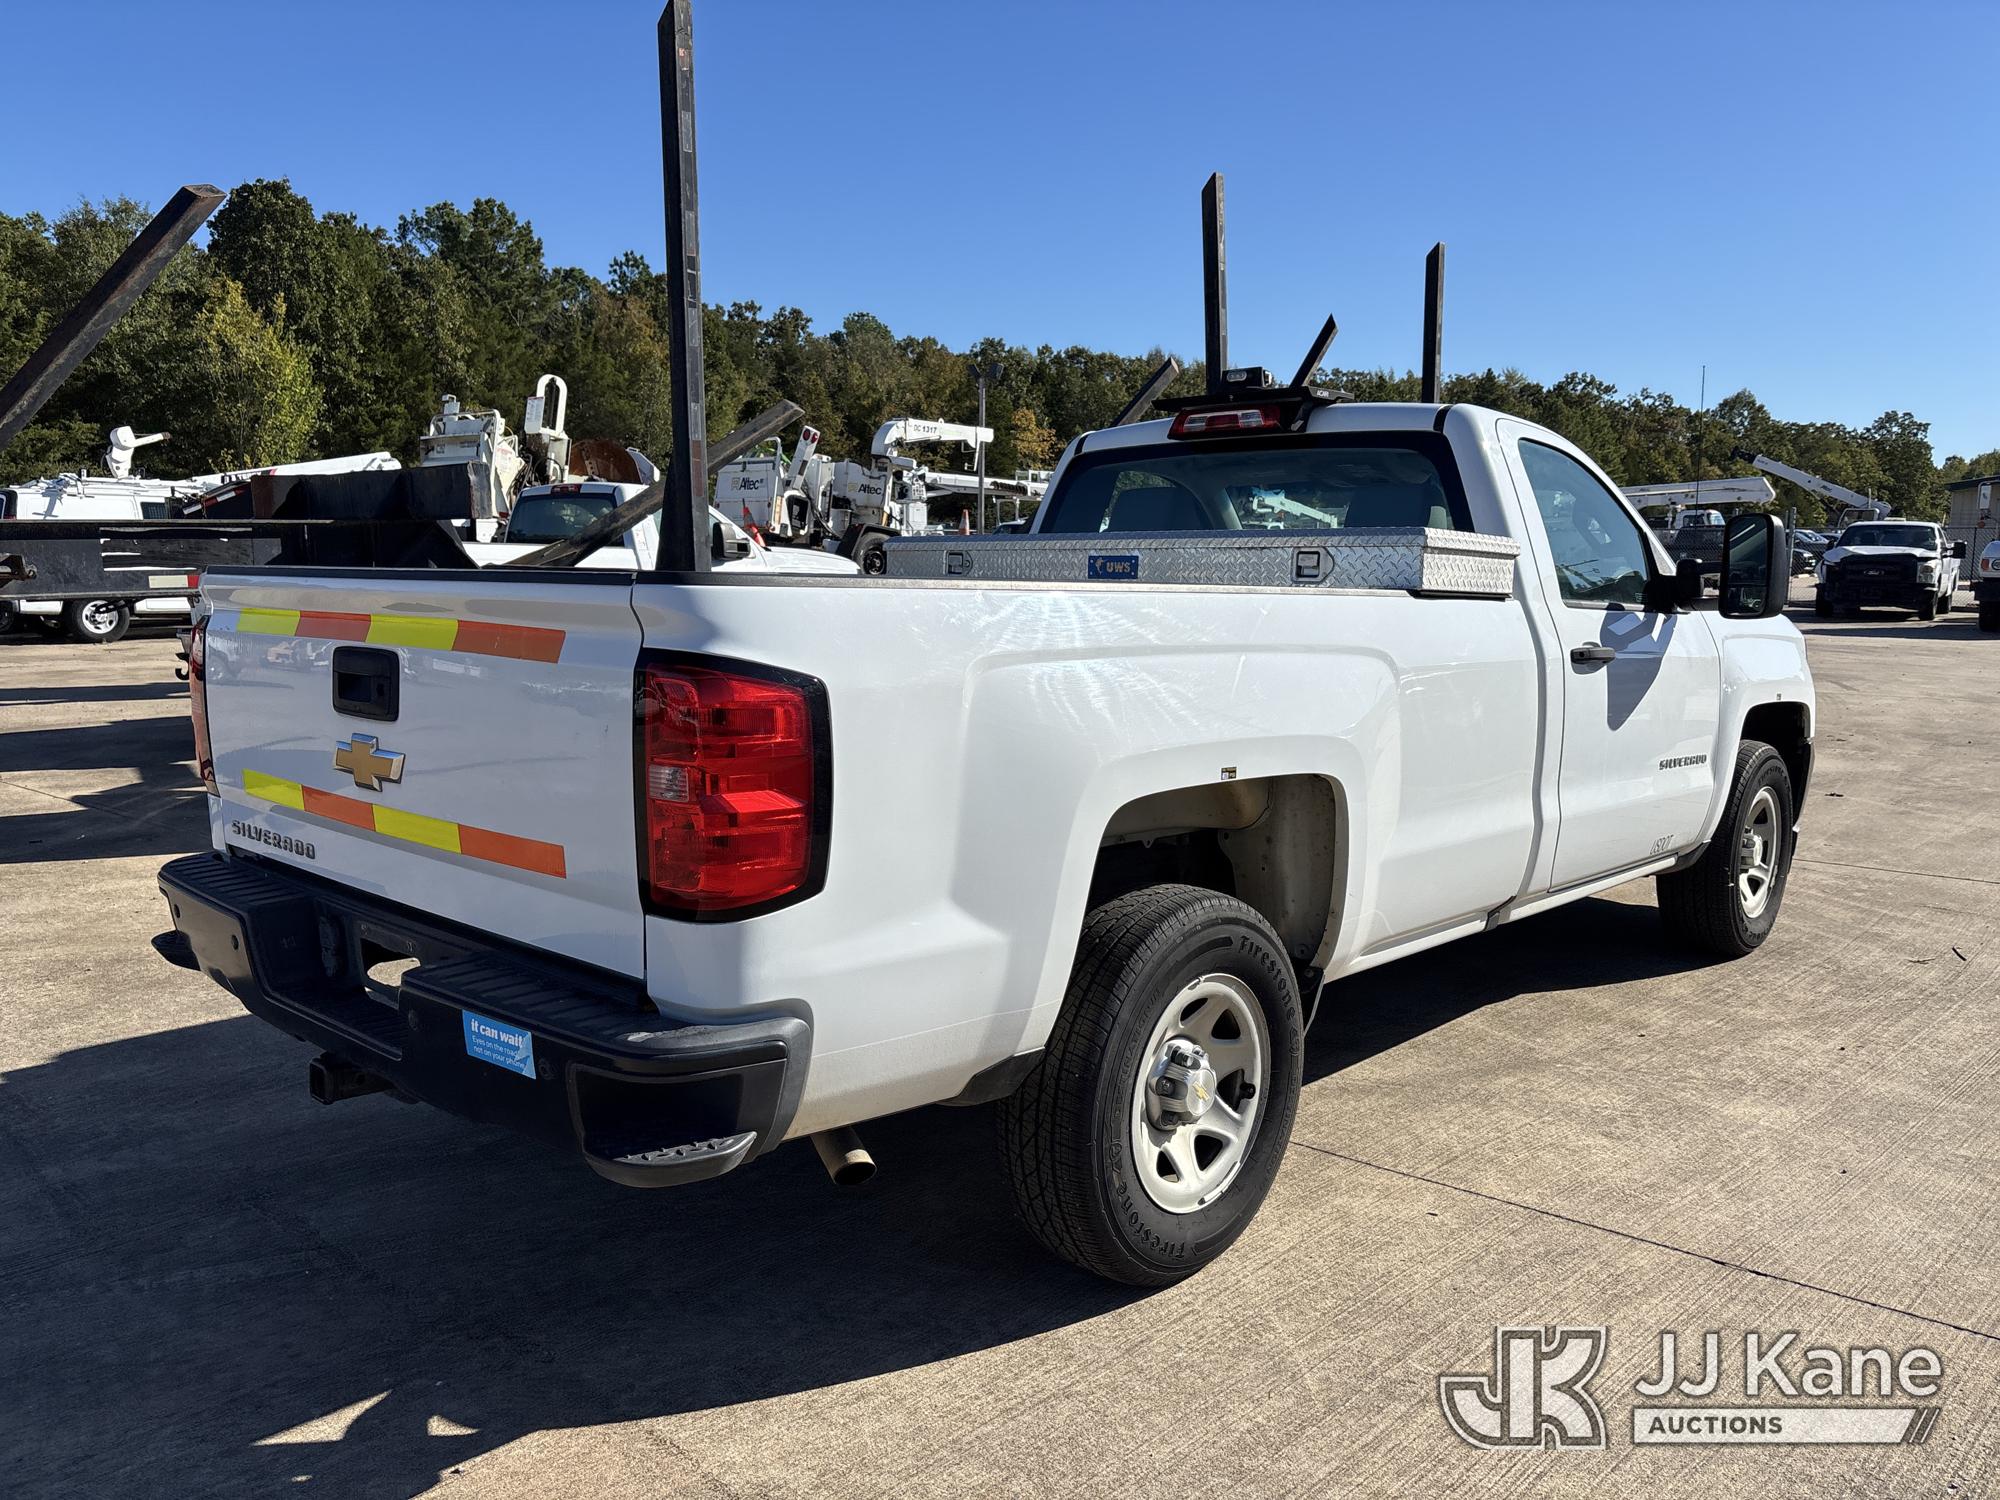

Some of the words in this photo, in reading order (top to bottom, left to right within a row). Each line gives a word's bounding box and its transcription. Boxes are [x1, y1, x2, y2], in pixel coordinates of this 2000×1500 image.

[922, 426, 937, 434] 1317
[739, 477, 759, 490] Altec
[858, 483, 882, 495] Altec
[1106, 561, 1131, 573] UWS
[231, 819, 316, 860] SILVERADO
[1237, 935, 1297, 1021] Firestone
[471, 1018, 479, 1033] it
[480, 1025, 498, 1040] can
[499, 1031, 523, 1049] wait
[472, 1035, 486, 1048] Eyes
[486, 1041, 494, 1049] on
[494, 1042, 504, 1053] the
[473, 1046, 483, 1055] not
[484, 1049, 492, 1057] on
[492, 1052, 505, 1062] your
